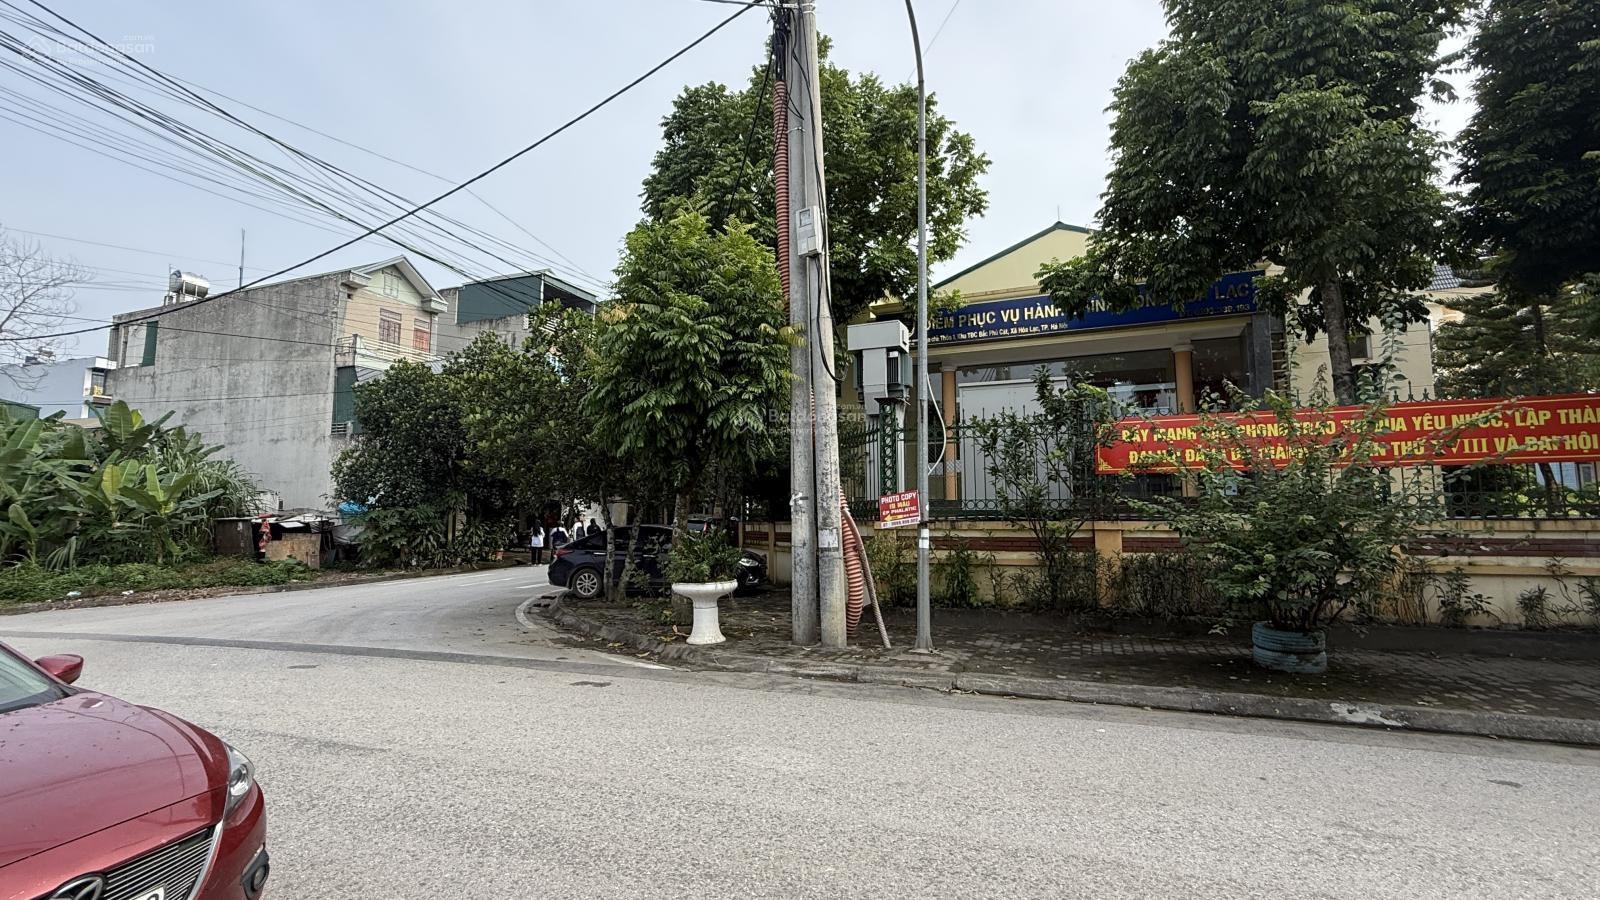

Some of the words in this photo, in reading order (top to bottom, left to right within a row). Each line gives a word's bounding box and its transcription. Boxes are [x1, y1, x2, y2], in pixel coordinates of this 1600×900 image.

[958, 312, 996, 329] PHỤC
[1000, 307, 1020, 325] VỤ
[1411, 412, 1446, 431] YÊU
[1514, 406, 1551, 430] LẬP
[1493, 432, 1519, 453] VÀ
[1564, 430, 1599, 453] HỘI
[881, 495, 900, 504] PHOTO
[901, 492, 917, 501] COPY
